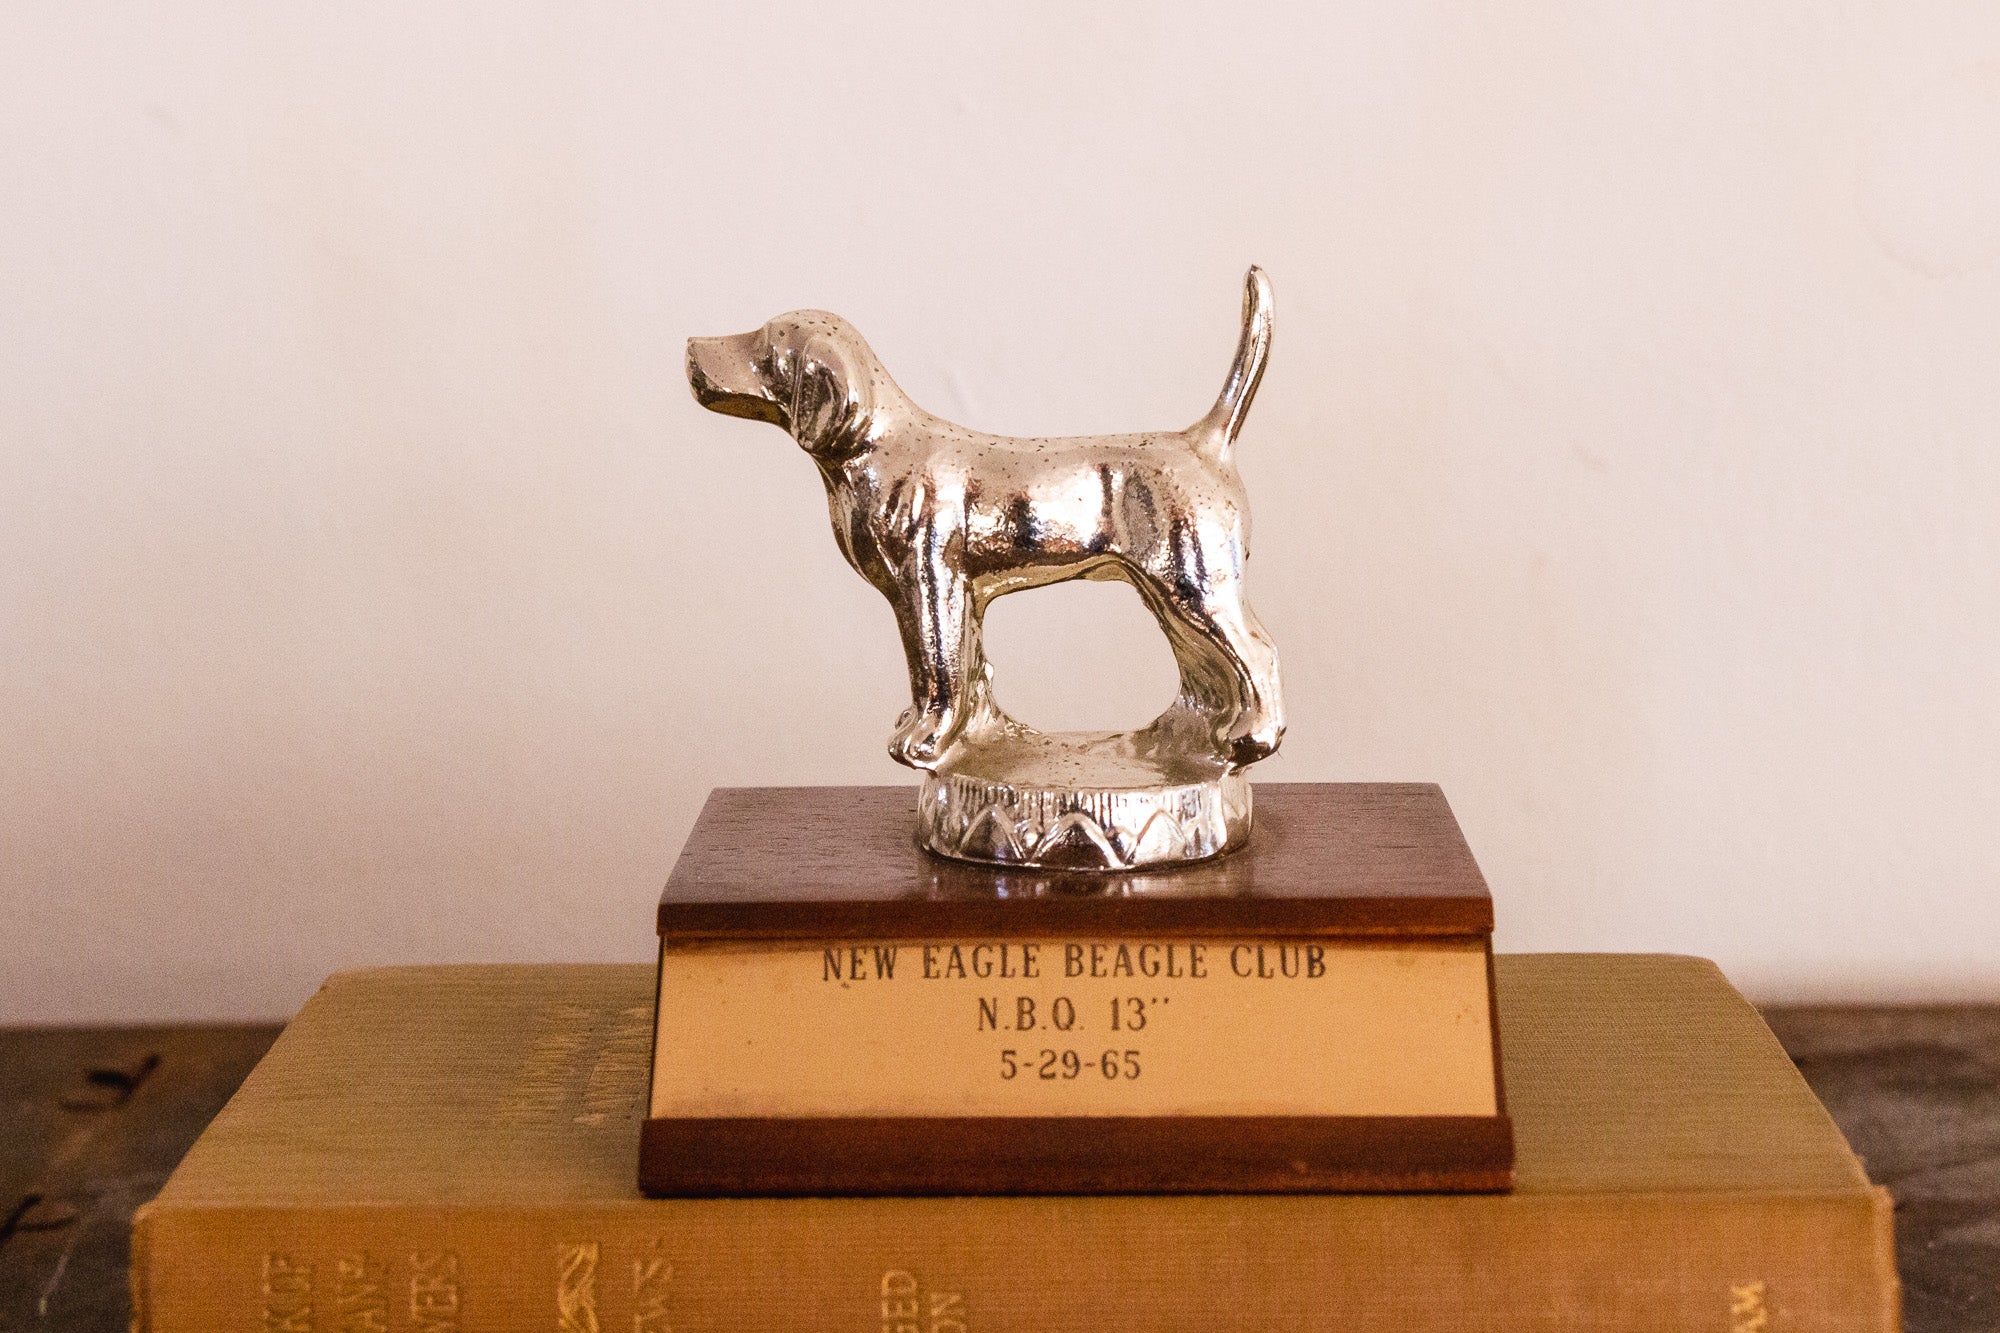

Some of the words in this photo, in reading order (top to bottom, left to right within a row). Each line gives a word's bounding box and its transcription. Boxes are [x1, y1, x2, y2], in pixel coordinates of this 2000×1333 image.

[822, 945, 898, 982] NEW
[923, 943, 1040, 979] EAGLE
[1065, 943, 1208, 979] BEAGLE
[1230, 943, 1326, 979] CLUB
[1000, 1049, 1142, 1081] 5-29-65
